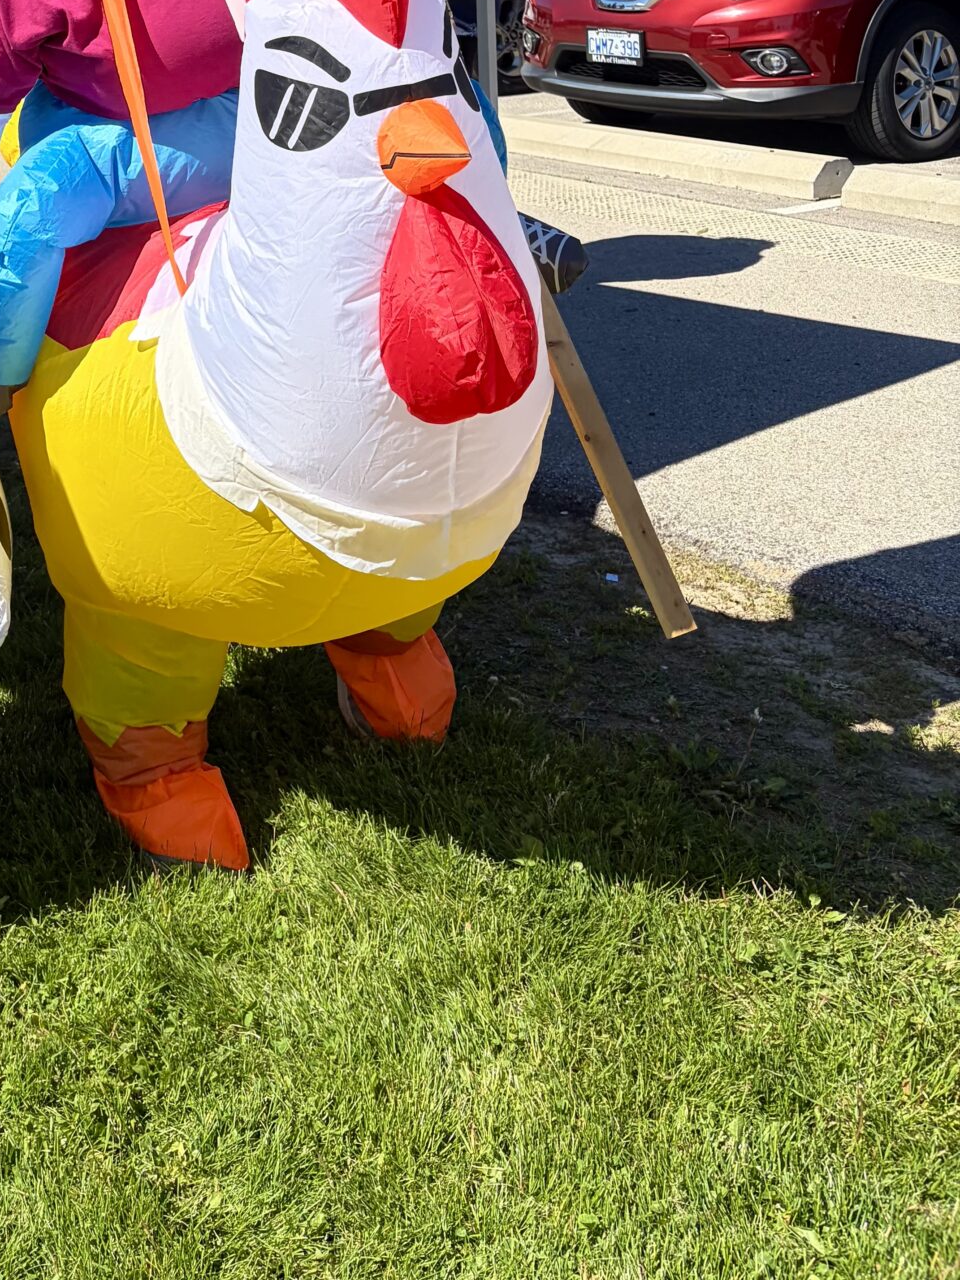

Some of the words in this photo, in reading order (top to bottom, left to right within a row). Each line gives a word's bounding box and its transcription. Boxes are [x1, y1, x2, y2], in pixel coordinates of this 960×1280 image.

[589, 37, 614, 55] CWMZ
[620, 39, 639, 57] 396
[592, 54, 606, 63] KIA
[613, 56, 637, 66] Hamilton
